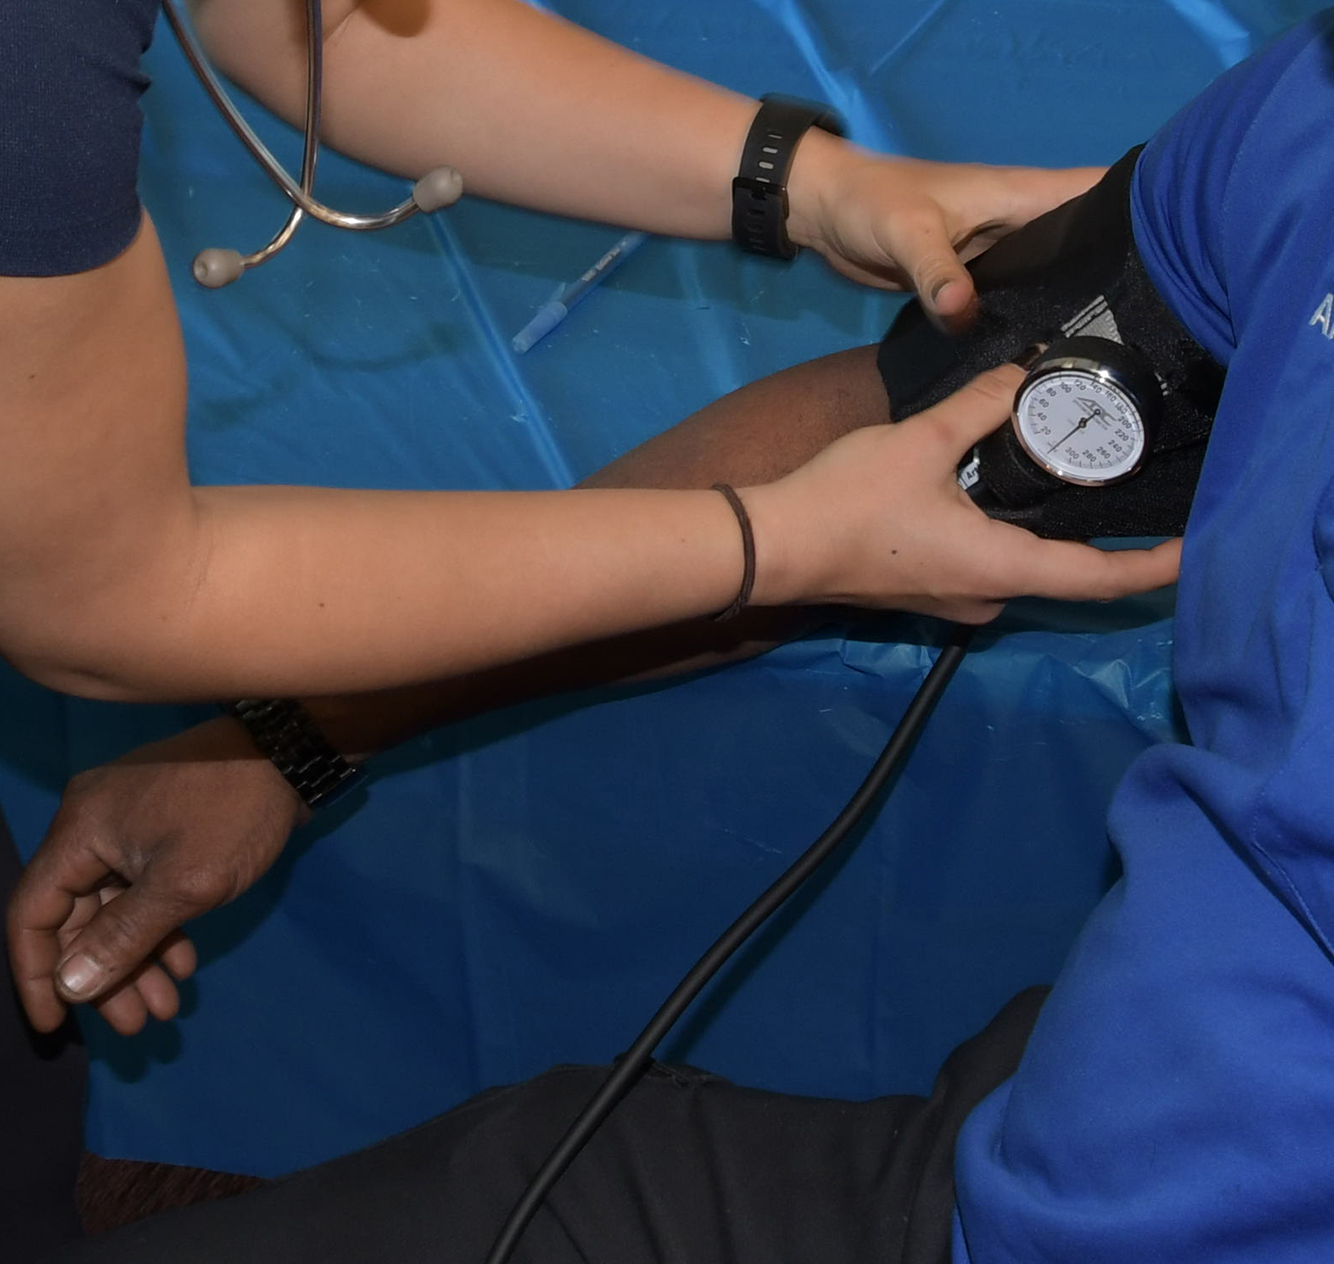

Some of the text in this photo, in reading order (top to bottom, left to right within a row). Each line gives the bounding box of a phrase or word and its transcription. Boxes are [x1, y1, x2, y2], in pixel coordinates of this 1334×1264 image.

[1046, 387, 1057, 397] 80
[1039, 398, 1049, 408] 60
[1037, 411, 1047, 421] 40
[1117, 416, 1132, 429] 200
[1114, 429, 1130, 442] 220
[1107, 439, 1123, 452] 240
[1065, 446, 1080, 460] 300
[1082, 449, 1097, 463] 280
[1096, 446, 1111, 459] 260
